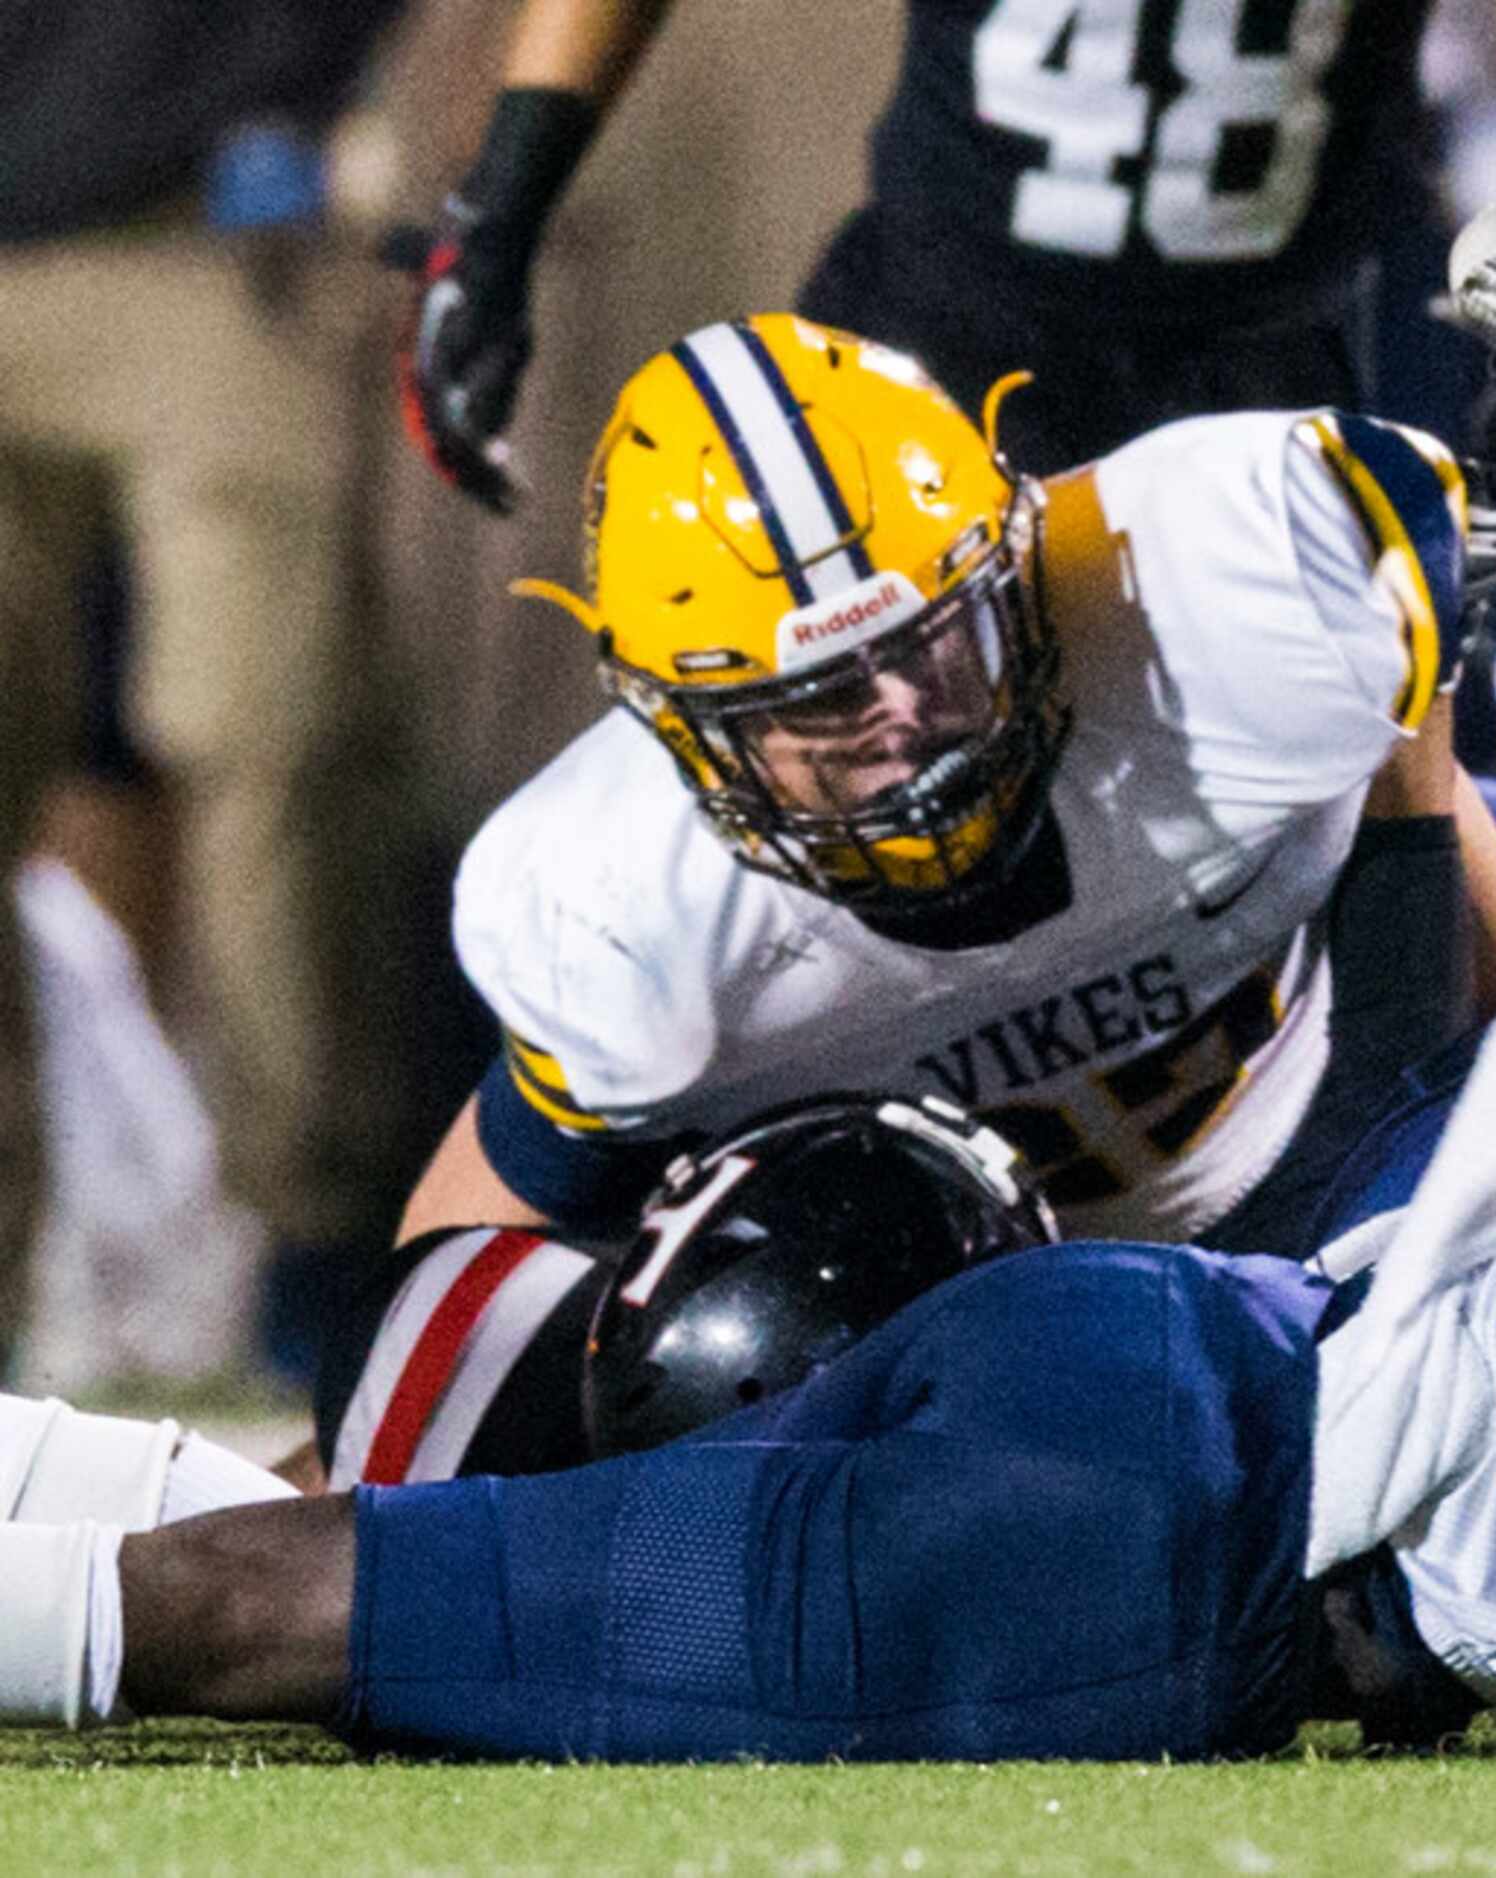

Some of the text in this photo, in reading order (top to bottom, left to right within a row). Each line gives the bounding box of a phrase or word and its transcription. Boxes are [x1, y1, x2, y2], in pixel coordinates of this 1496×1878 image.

[973, 0, 1352, 261] 48
[793, 582, 901, 646] Riddell
[914, 953, 1191, 1107] VIKES
